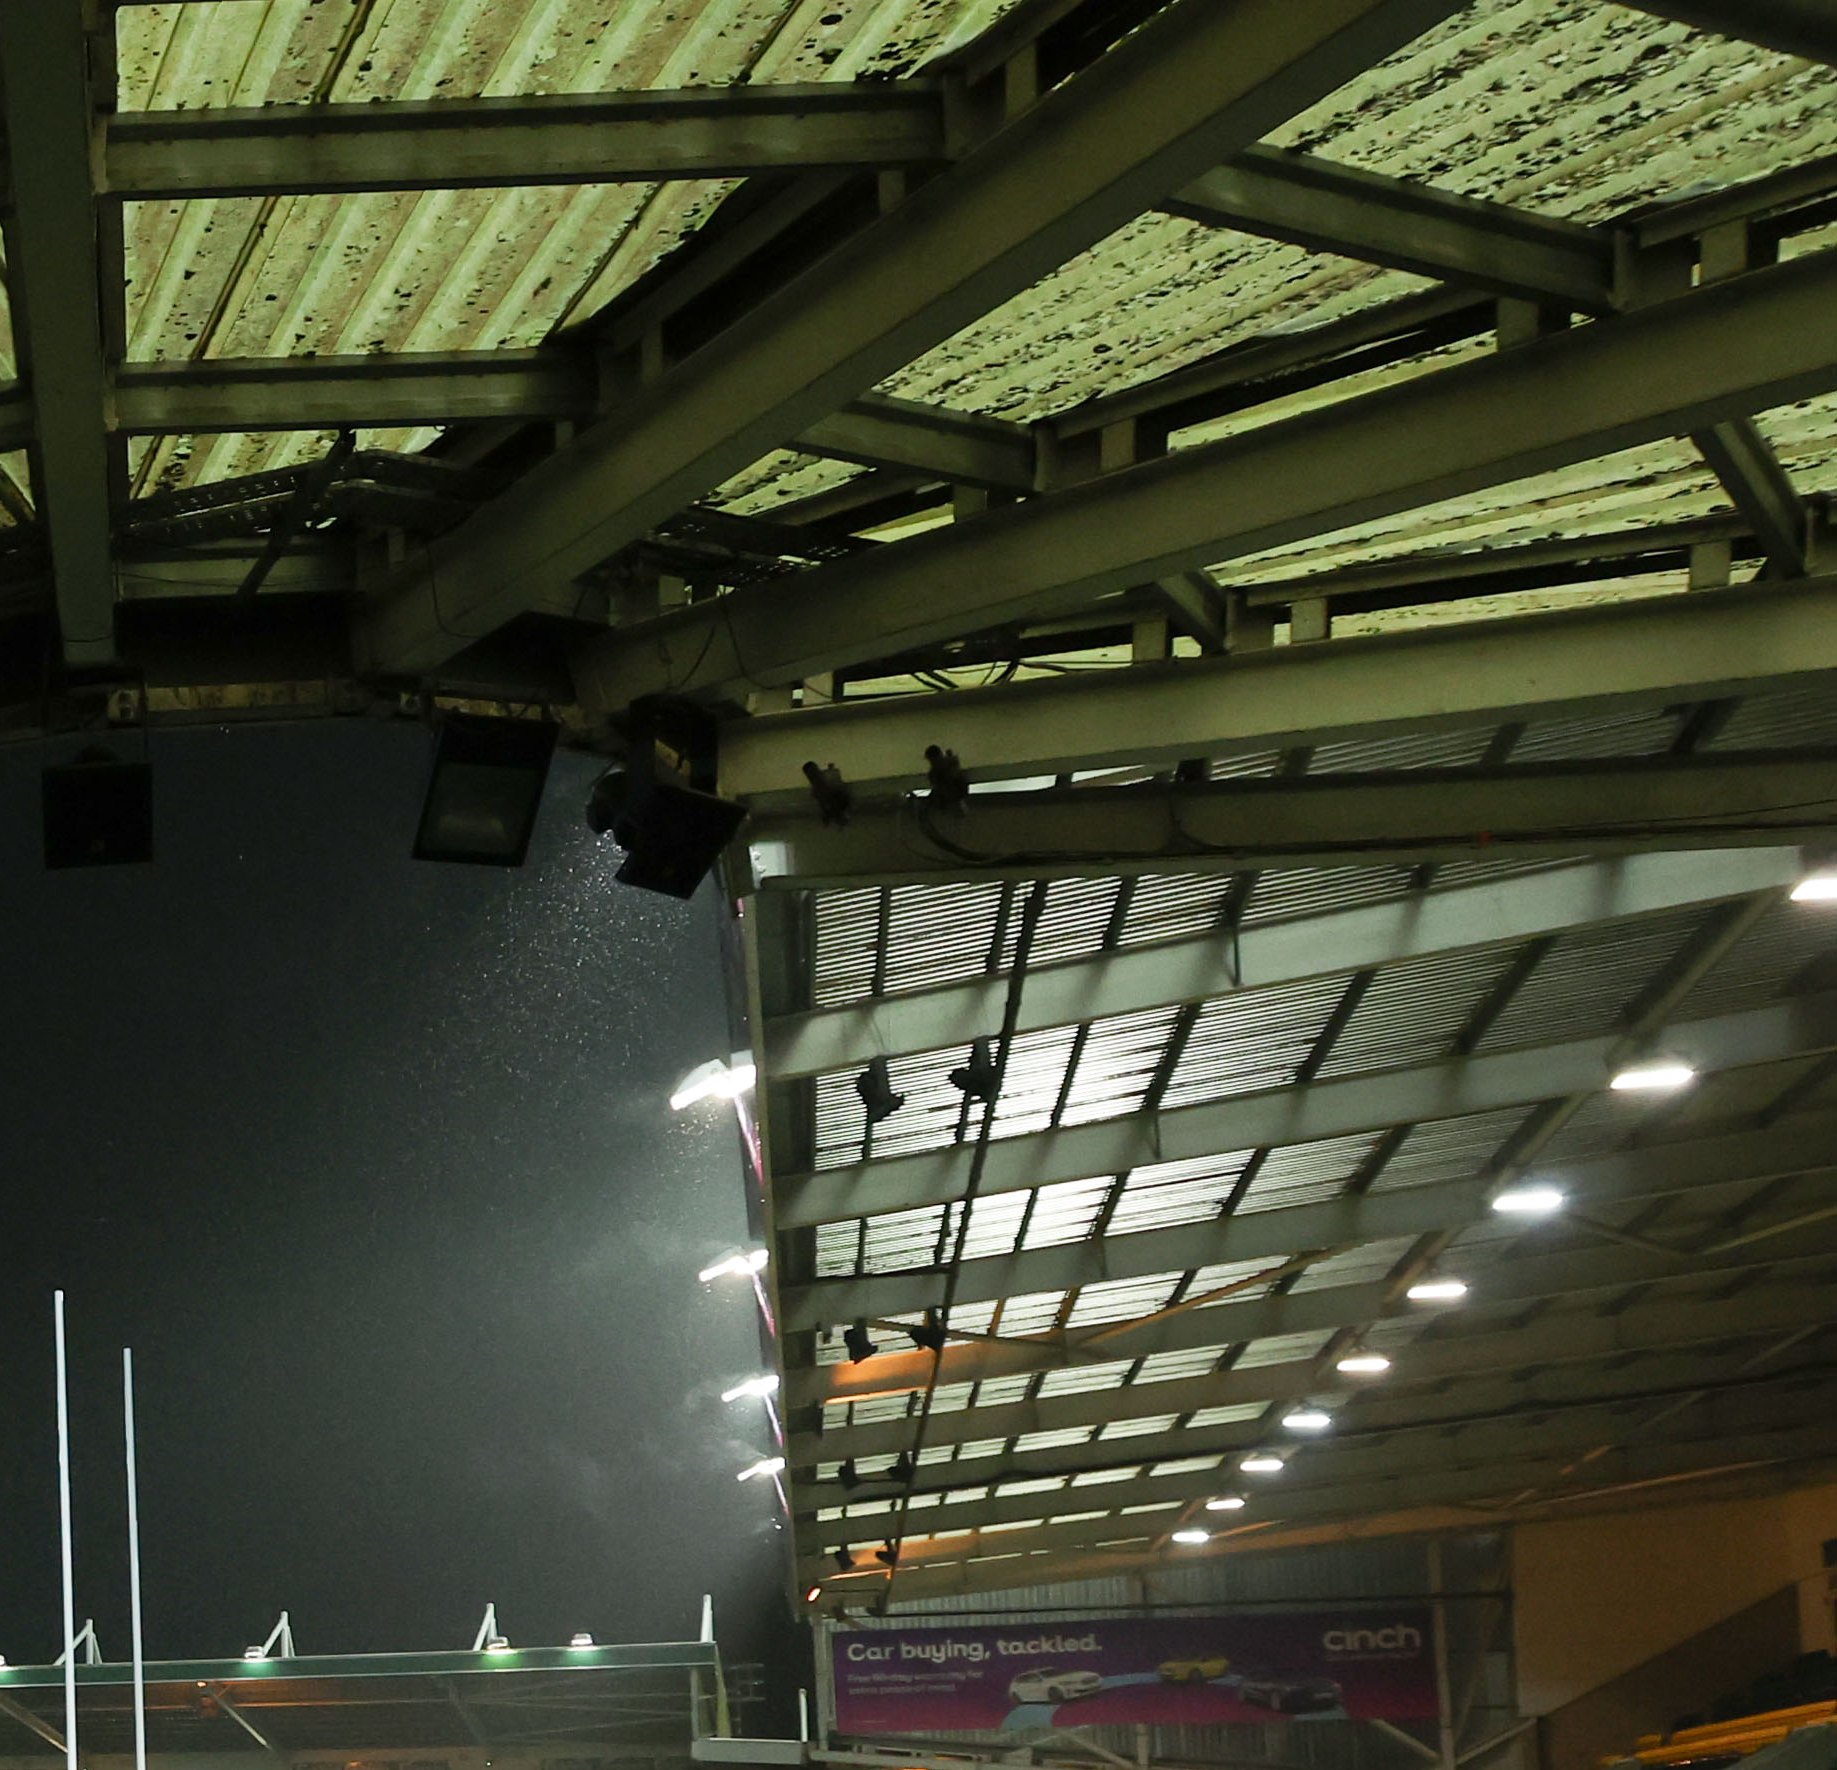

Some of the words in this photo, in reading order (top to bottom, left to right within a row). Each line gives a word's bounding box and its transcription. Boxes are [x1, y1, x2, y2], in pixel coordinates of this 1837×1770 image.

[847, 1643, 894, 1662] Car
[901, 1638, 991, 1664] buying,
[996, 1633, 1103, 1656] tackled.
[1323, 1624, 1421, 1651] cinch
